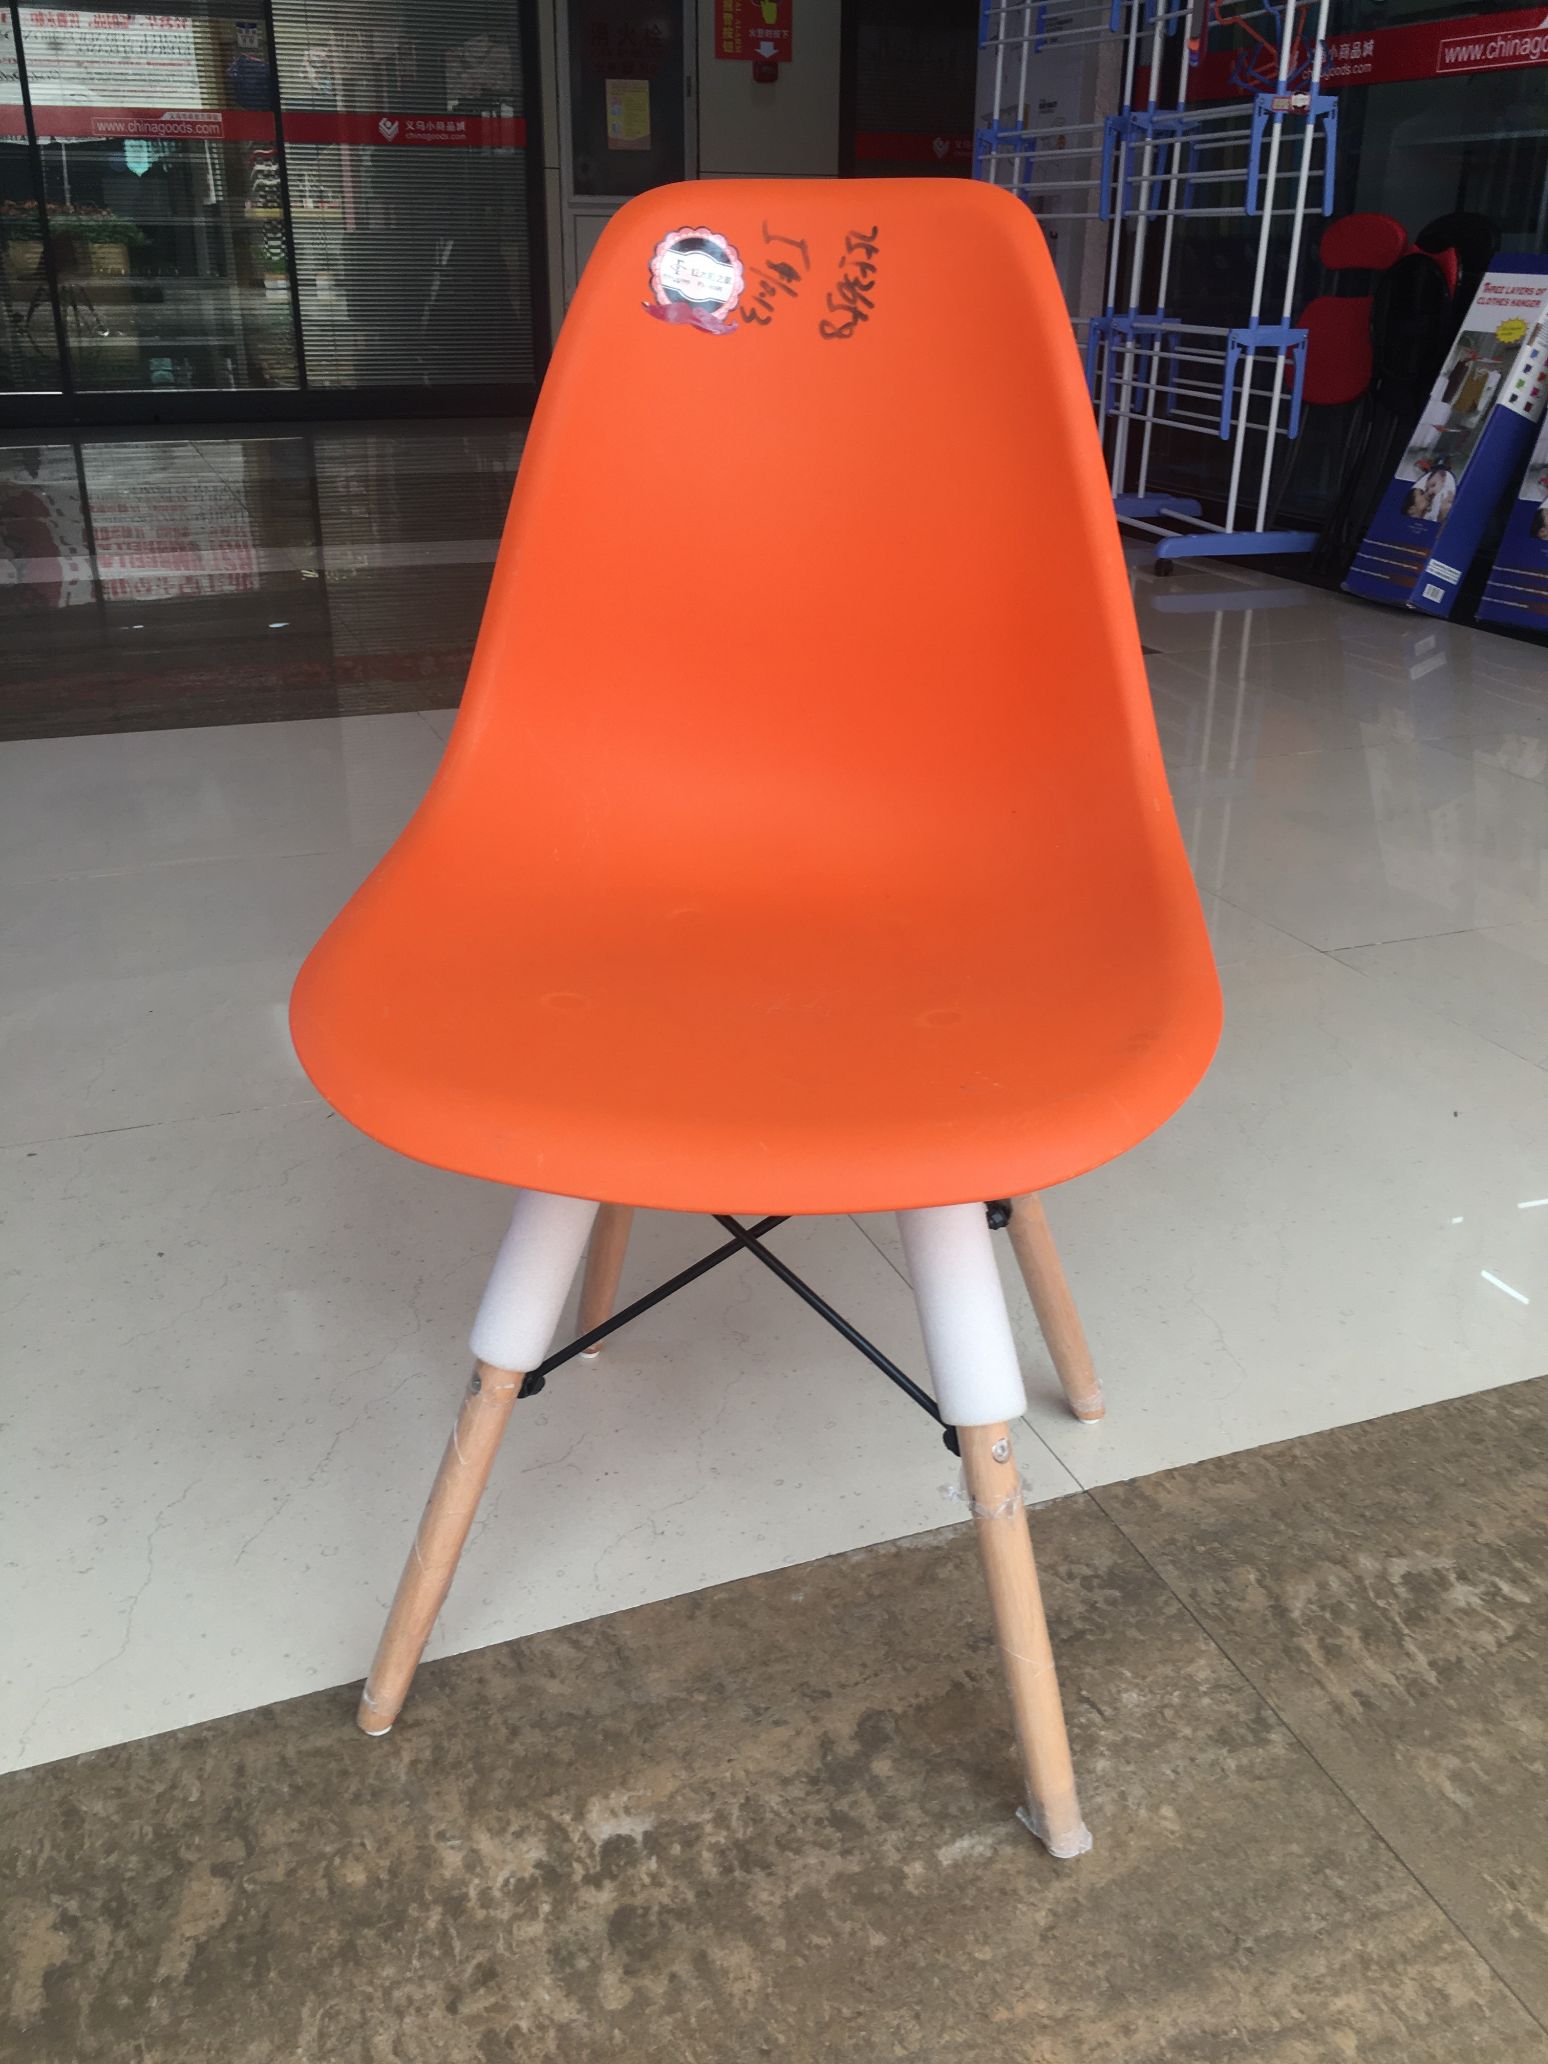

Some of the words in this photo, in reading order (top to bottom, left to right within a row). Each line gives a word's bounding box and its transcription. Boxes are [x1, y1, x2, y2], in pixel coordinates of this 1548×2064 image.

[96, 119, 220, 136] www.chinagoods.com
[1483, 282, 1505, 294] THREE
[1505, 286, 1534, 295] LAYERS
[1534, 287, 1548, 296] OF
[1476, 296, 1510, 305] CLOTHES
[1510, 299, 1542, 308] HANGER
